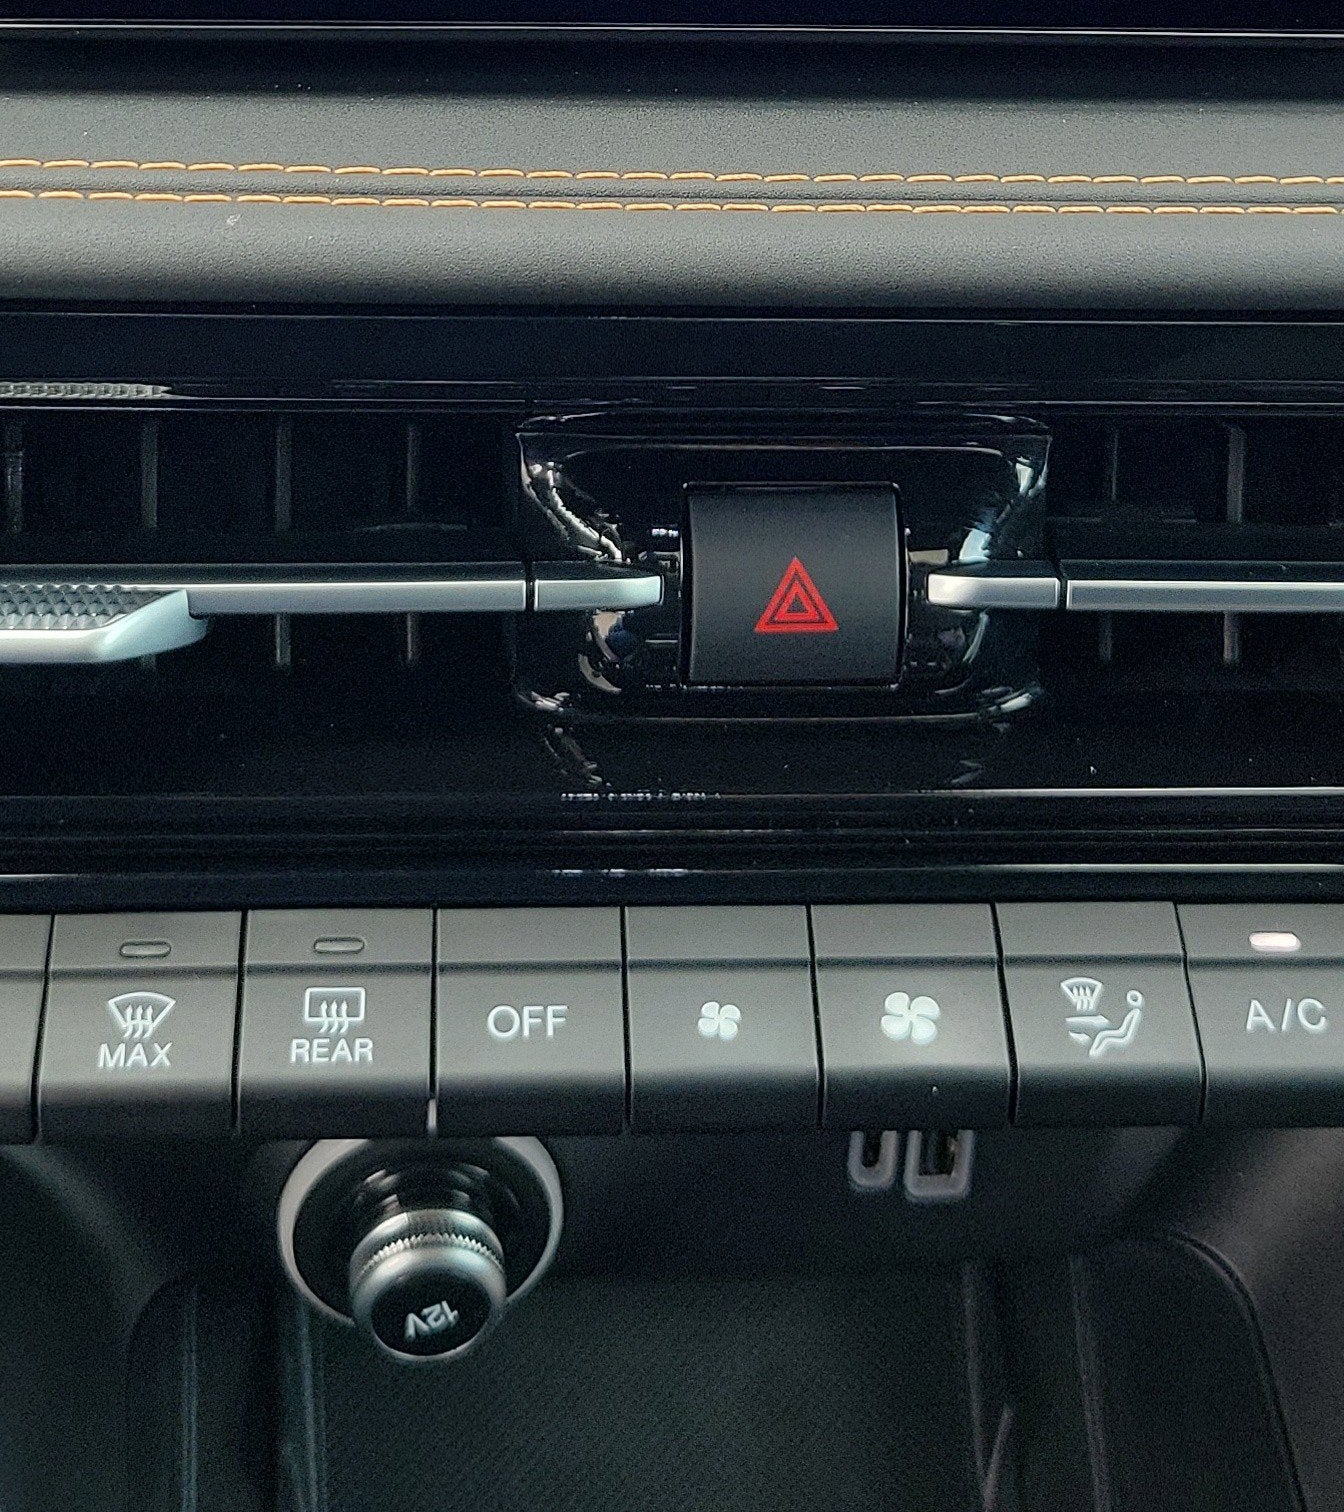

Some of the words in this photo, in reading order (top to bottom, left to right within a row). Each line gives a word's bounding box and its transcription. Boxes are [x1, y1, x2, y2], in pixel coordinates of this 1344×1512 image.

[487, 1004, 568, 1039] OFF
[1245, 998, 1328, 1034] A/C
[97, 1042, 174, 1069] MAX
[290, 1037, 374, 1064] REAR
[405, 1300, 459, 1339] 12V
